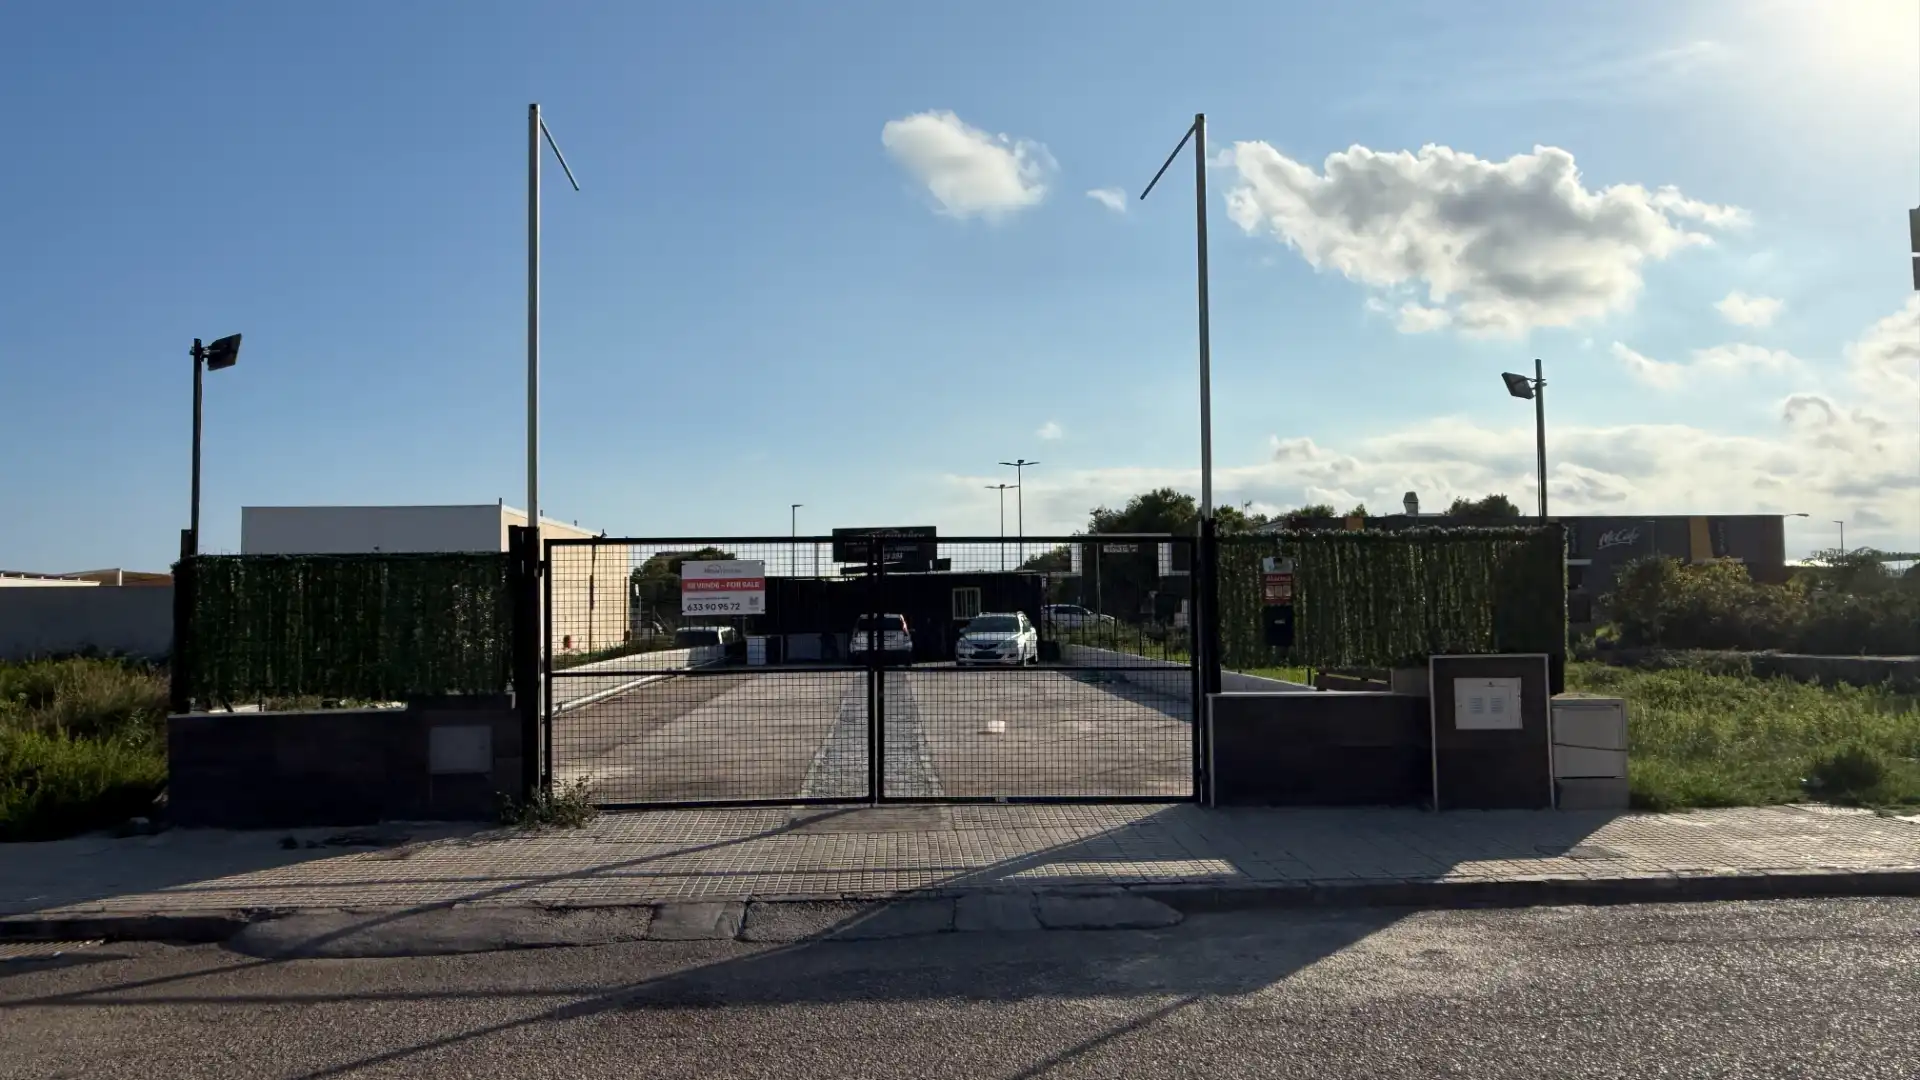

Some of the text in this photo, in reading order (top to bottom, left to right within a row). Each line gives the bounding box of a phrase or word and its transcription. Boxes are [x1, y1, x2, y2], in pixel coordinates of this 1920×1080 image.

[726, 581, 742, 589] FOR
[687, 603, 704, 611] 633
[705, 603, 717, 611] 90
[731, 602, 741, 610] 72
